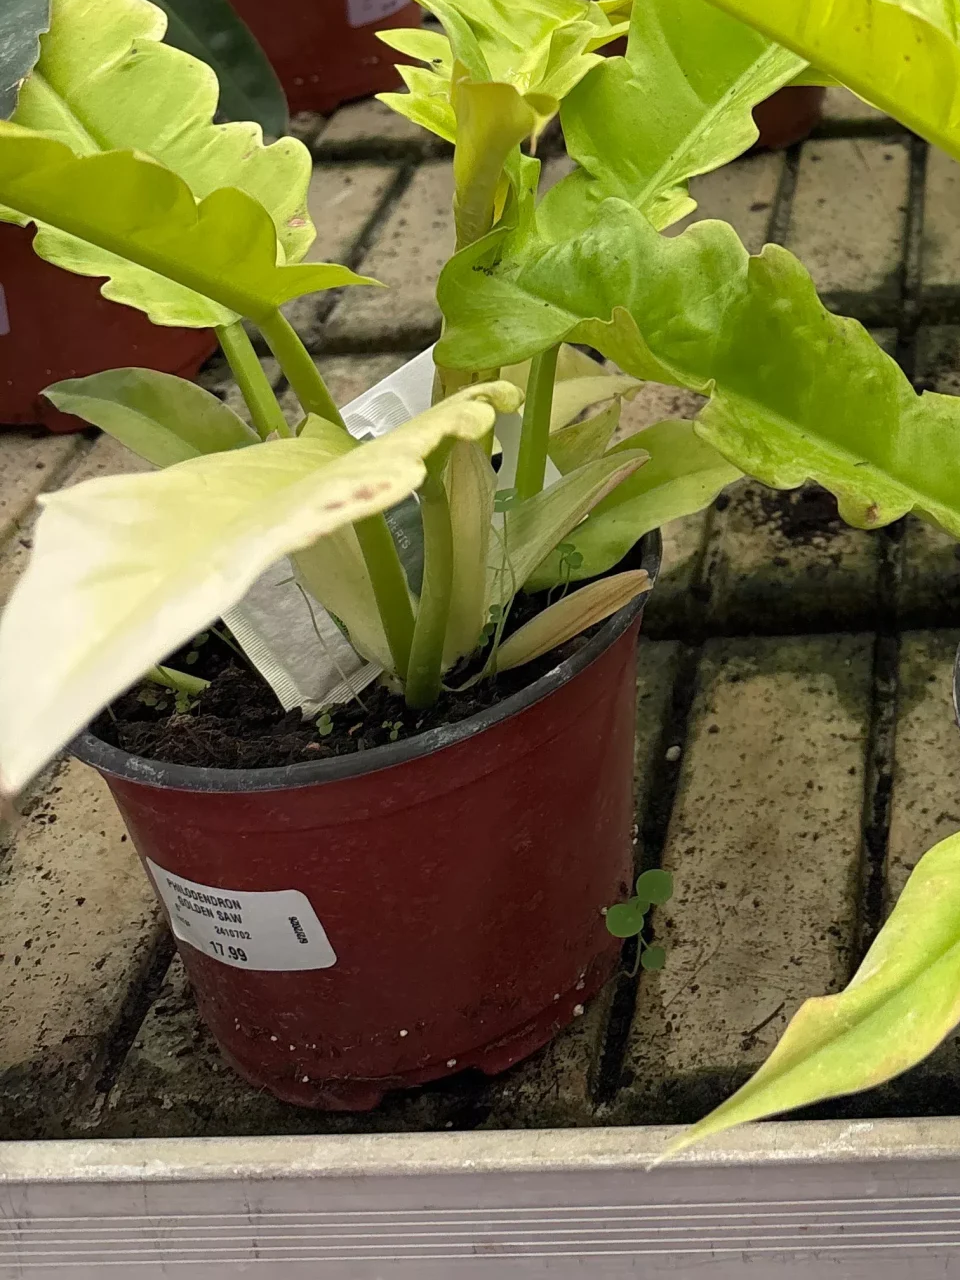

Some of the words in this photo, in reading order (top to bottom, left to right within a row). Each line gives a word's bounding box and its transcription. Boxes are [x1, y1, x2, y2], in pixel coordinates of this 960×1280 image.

[166, 878, 242, 910] PHILODENDRON
[177, 895, 215, 919] GOLDEN
[216, 910, 242, 924] SAW
[214, 925, 252, 940] 2410702
[209, 941, 248, 961] 17.99
